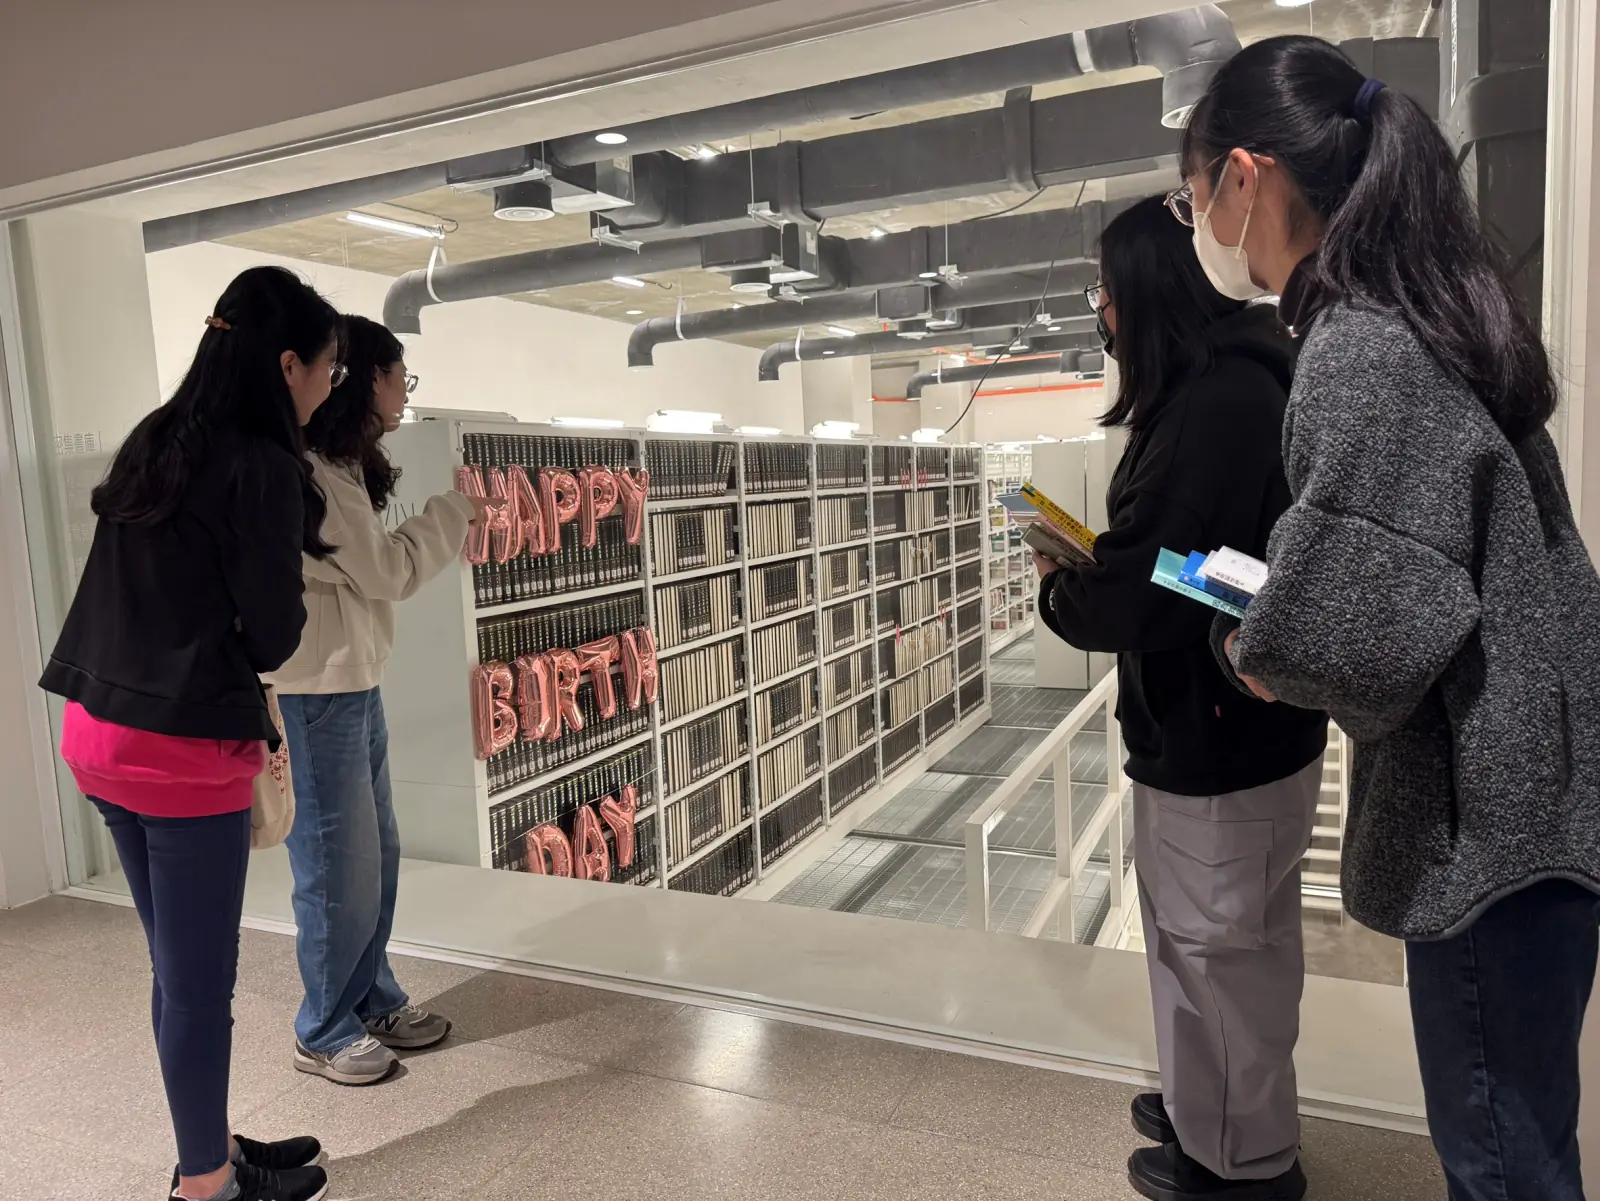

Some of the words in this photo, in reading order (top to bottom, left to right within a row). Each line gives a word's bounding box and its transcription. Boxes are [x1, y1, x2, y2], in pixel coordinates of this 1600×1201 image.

[460, 463, 649, 564] HAPPY
[472, 626, 658, 760] BIRTH
[526, 784, 637, 881] DAY
